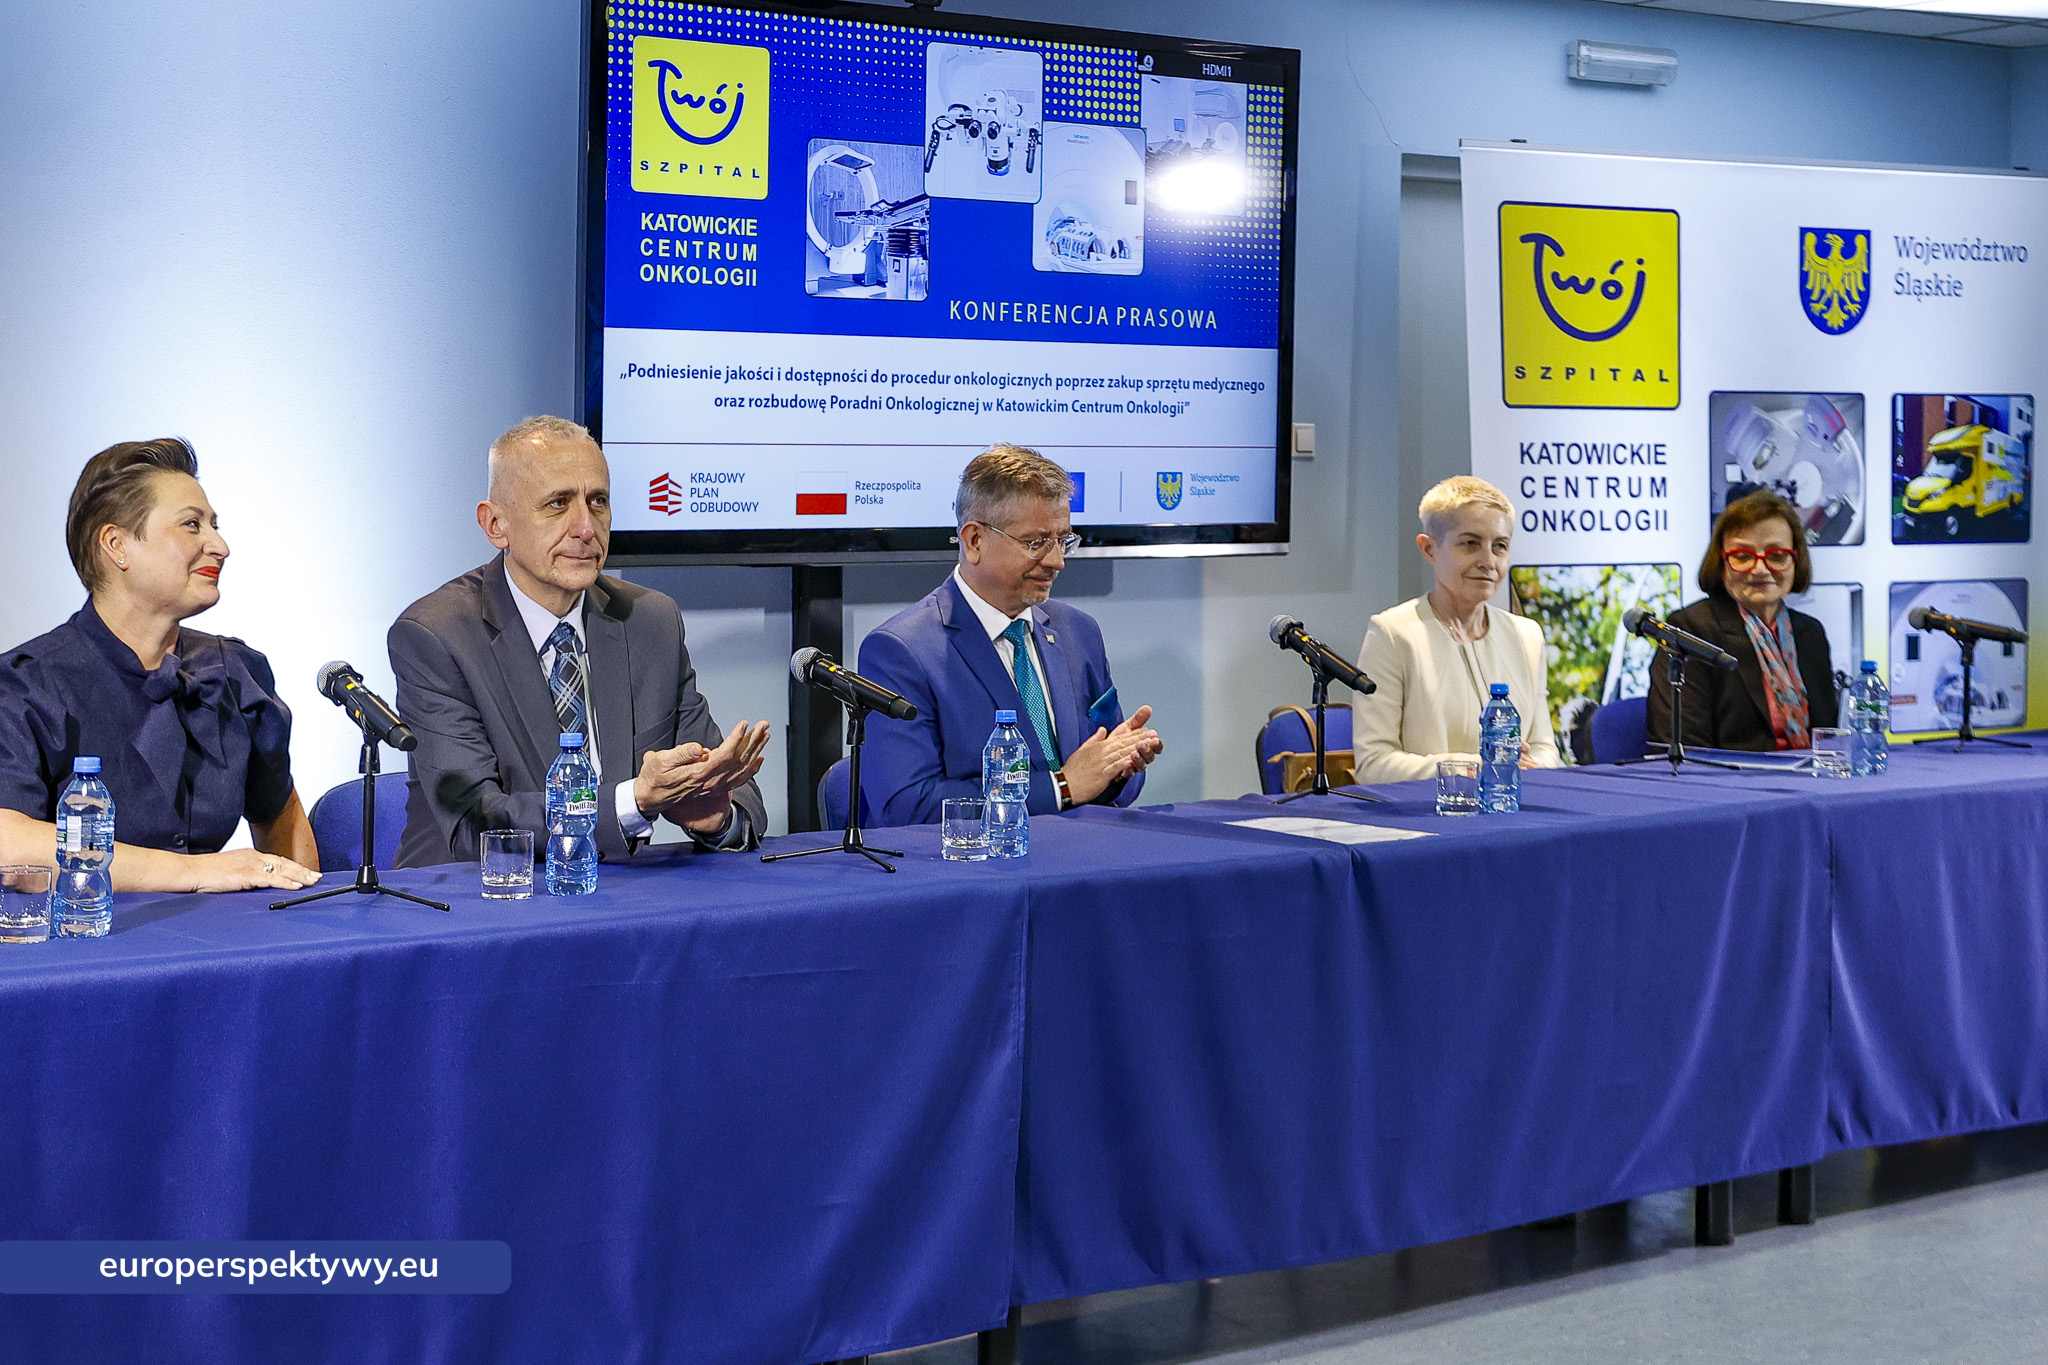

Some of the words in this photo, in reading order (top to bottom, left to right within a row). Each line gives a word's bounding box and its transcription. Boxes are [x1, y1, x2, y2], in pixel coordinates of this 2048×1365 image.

[1202, 63, 1232, 77] HDMI1
[648, 60, 744, 145] Twój
[640, 160, 760, 179] SZPITAL
[641, 212, 758, 236] KATOWICKIE
[640, 238, 757, 261] CENTRUM
[1893, 235, 2029, 265] Województwo
[639, 264, 757, 286] ONKOLOGII
[1894, 267, 1963, 303] Śląskie
[1520, 233, 1646, 342] Twój
[949, 300, 1109, 326] KONFERENCJA
[1116, 307, 1218, 330] PRASOWA
[724, 365, 774, 384] jakości
[777, 366, 781, 381] i
[785, 366, 868, 386] dostępności
[870, 369, 888, 384] do
[891, 369, 951, 387] procedur
[954, 371, 1052, 390] onkologicznych
[1055, 377, 1105, 391] poprzez
[1107, 373, 1144, 392] zakup
[1146, 377, 1190, 394] sprzętu
[1193, 377, 1265, 395] medycznego
[1514, 365, 1669, 382] SZPITAL
[714, 396, 745, 408] oraz
[749, 393, 827, 413] rozbudowę
[830, 394, 882, 410] Poradni
[885, 395, 980, 415] Onkologicznej
[982, 400, 993, 412] w
[996, 398, 1069, 413] Katowickim
[1071, 400, 1124, 414] Centrum
[1519, 442, 1668, 465] KATOWICKIE
[690, 472, 745, 484] KRAJOWY
[855, 480, 921, 493] Rzeczpospolita
[1520, 476, 1668, 498] CENTRUM
[690, 487, 719, 498] PLAN
[855, 495, 884, 505] Polska
[690, 502, 759, 513] ODBUDOWY
[1521, 509, 1668, 532] ONKOLOGII
